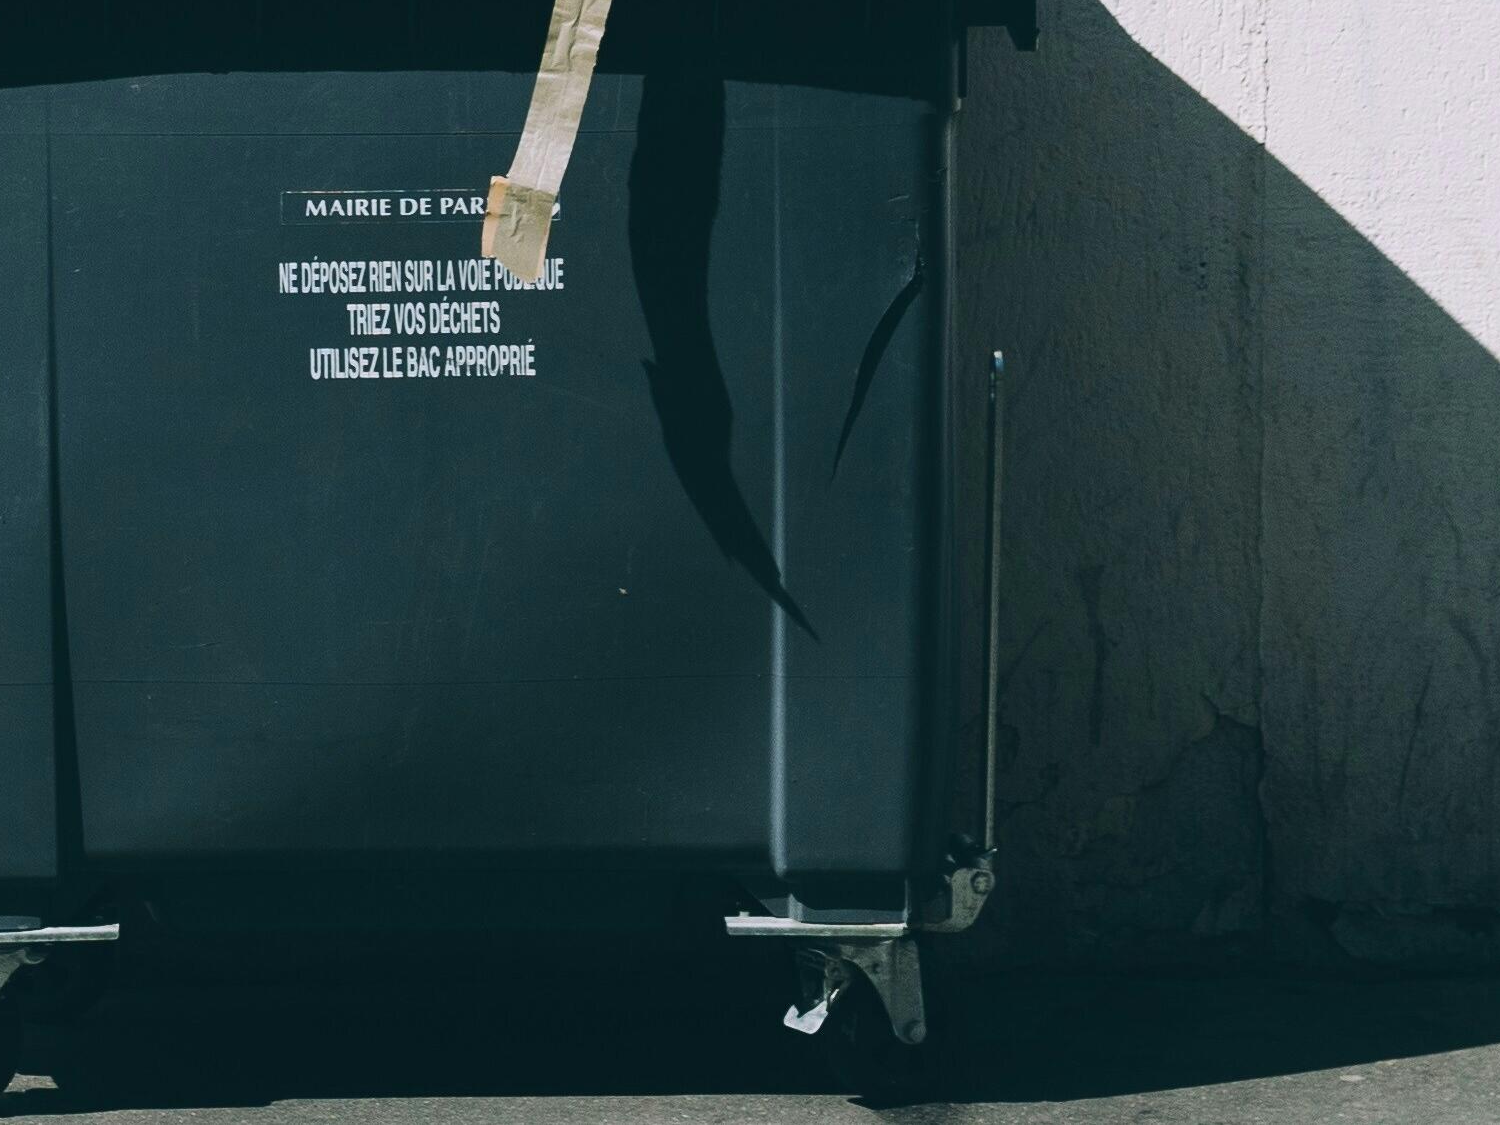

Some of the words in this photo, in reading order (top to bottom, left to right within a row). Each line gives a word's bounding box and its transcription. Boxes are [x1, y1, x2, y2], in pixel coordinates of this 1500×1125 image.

[305, 198, 392, 217] MAIRIE
[400, 198, 432, 216] DE
[440, 196, 488, 215] PAR
[279, 262, 298, 294] NE
[301, 256, 367, 294] DÉPOSEZ
[369, 261, 401, 292] RIEN
[404, 260, 433, 292] SUR
[437, 260, 456, 291] LA
[458, 259, 491, 291] VOIE
[494, 258, 564, 290] PUUE
[347, 304, 391, 335] TRIEZ
[394, 303, 426, 334] VOS
[430, 296, 501, 334] DÉCHETS
[310, 347, 379, 379] UTILISEZ
[383, 347, 402, 378] LE
[407, 347, 441, 377] BAC
[444, 339, 537, 377] APPROPRIÉ
